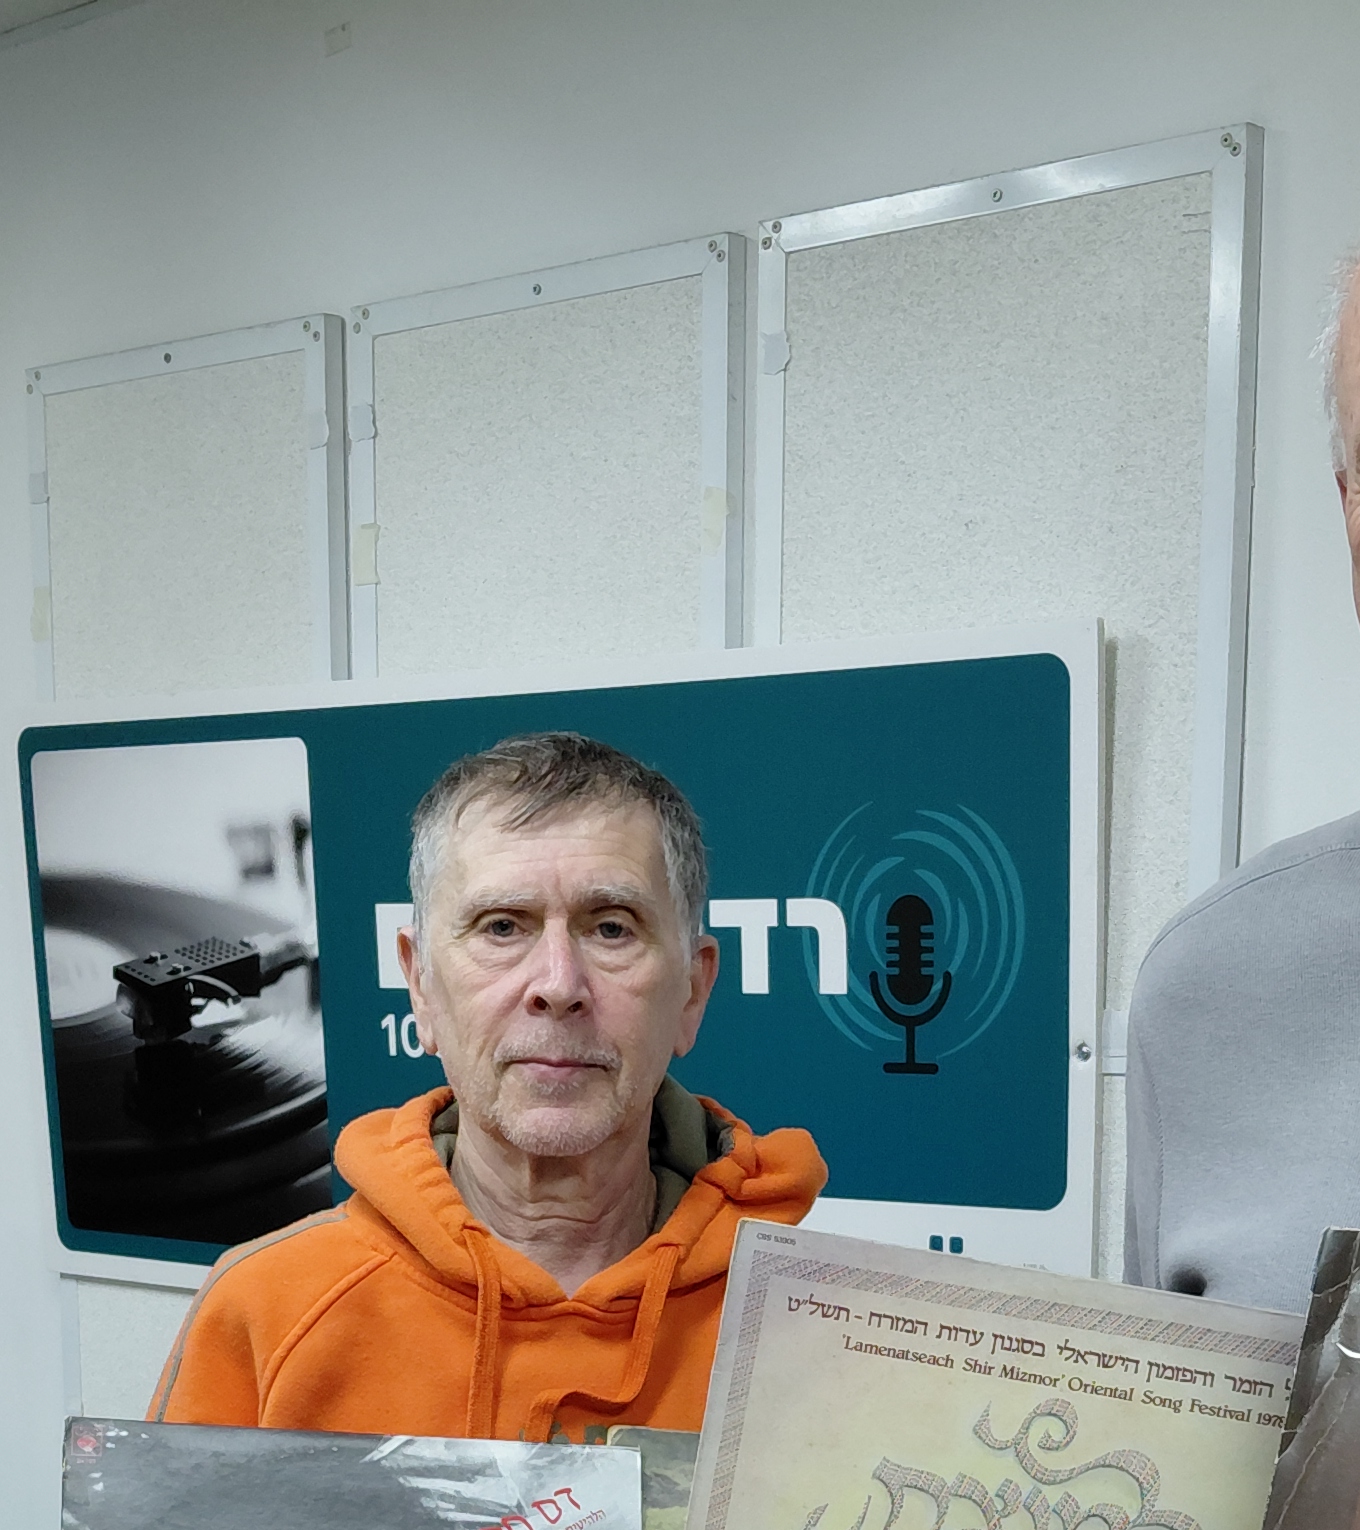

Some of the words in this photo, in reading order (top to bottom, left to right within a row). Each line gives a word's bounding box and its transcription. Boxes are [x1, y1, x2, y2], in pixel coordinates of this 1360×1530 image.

[867, 1310, 928, 1336] המזרח
[936, 1322, 984, 1347] עדות
[991, 1330, 1046, 1357] בסגנון
[1056, 1339, 1140, 1374] הישראלי
[1146, 1360, 1215, 1388] והפזמון
[1224, 1373, 1274, 1398] הזמר
[962, 1358, 996, 1376] Shir
[1067, 1376, 1134, 1402] Oriental
[1140, 1390, 1184, 1414] Song
[1188, 1398, 1251, 1423] Festival
[531, 1487, 581, 1525] דם
